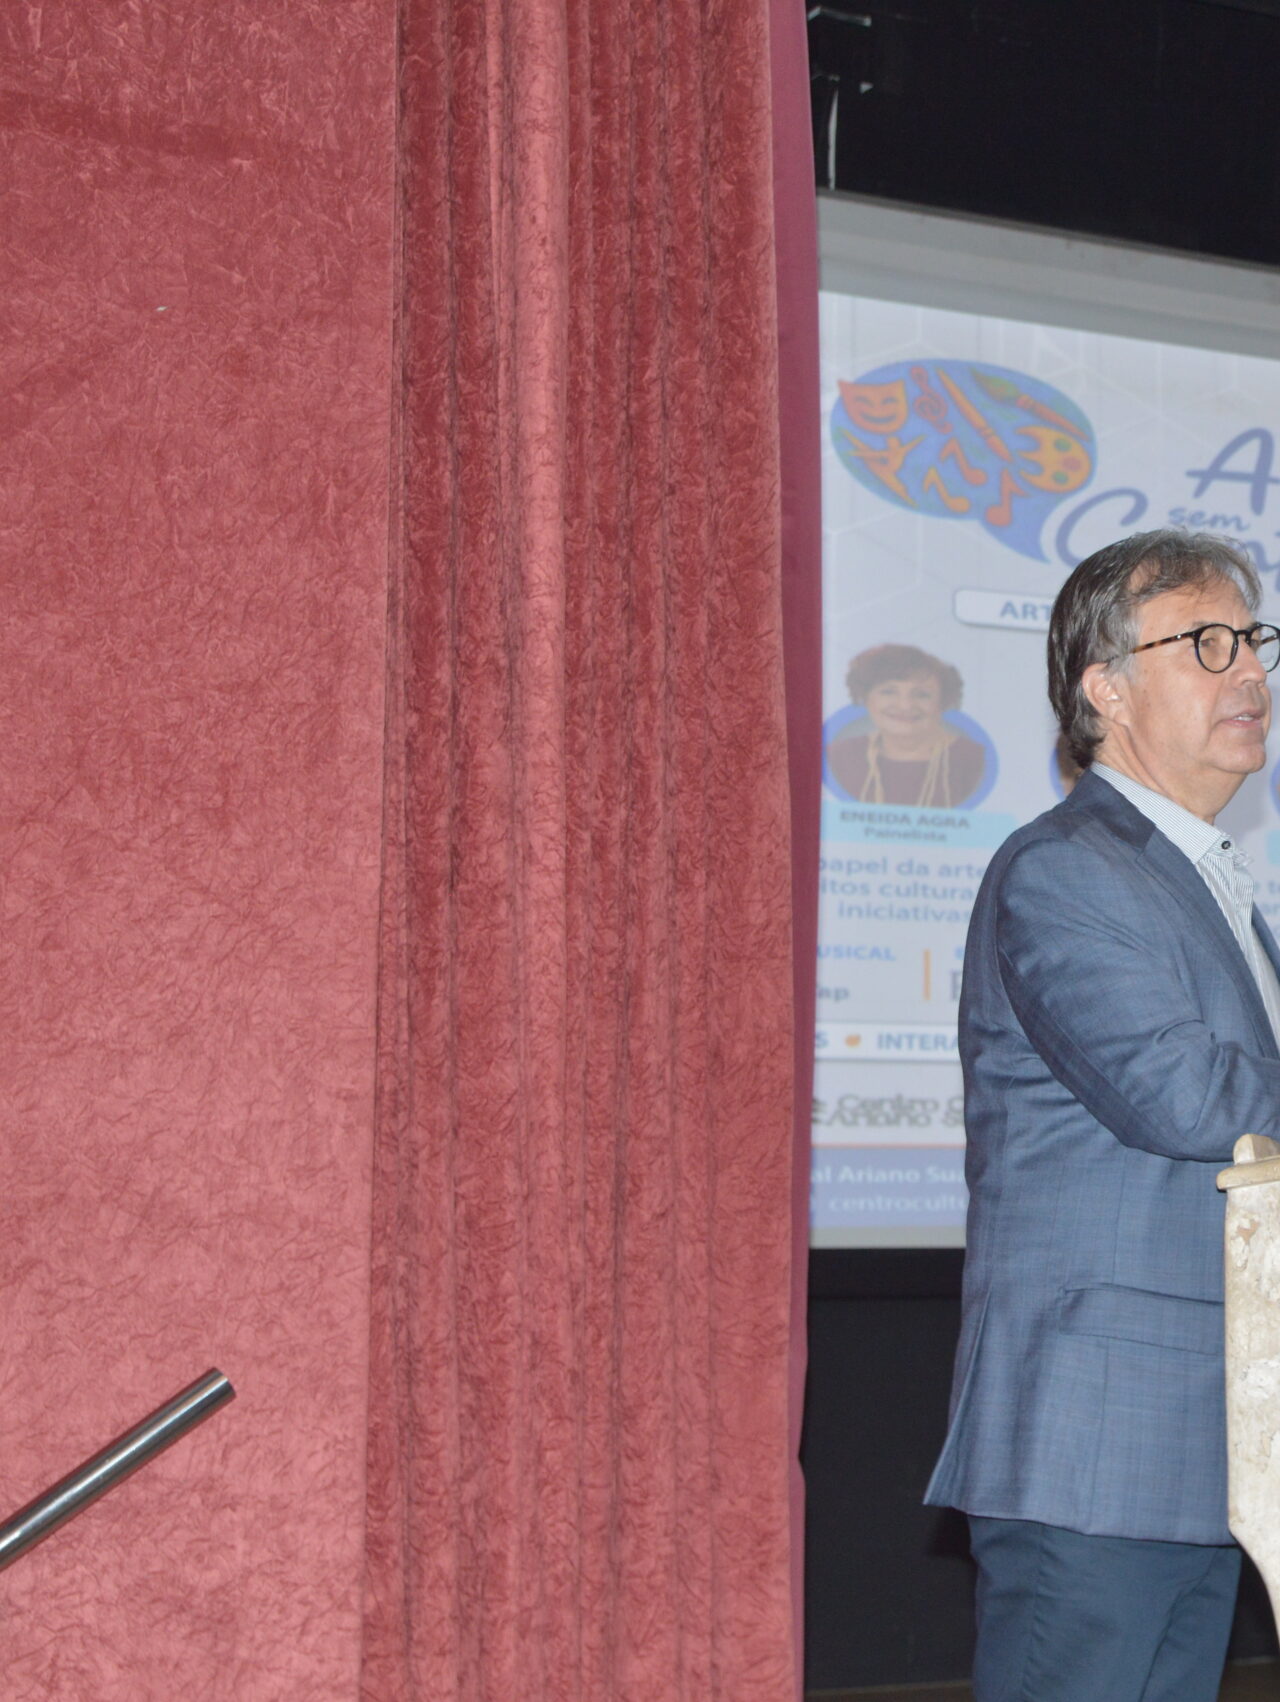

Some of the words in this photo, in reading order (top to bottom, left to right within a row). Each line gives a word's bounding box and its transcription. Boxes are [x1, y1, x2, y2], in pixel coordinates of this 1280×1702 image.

[1168, 507, 1249, 531] sem
[1000, 601, 1051, 620] ART
[840, 810, 911, 825] ENEIDA
[917, 813, 970, 828] AGRA
[896, 857, 929, 876] da
[879, 881, 974, 900] cultura
[817, 946, 896, 961] USICAL
[877, 1032, 958, 1050] INTERA
